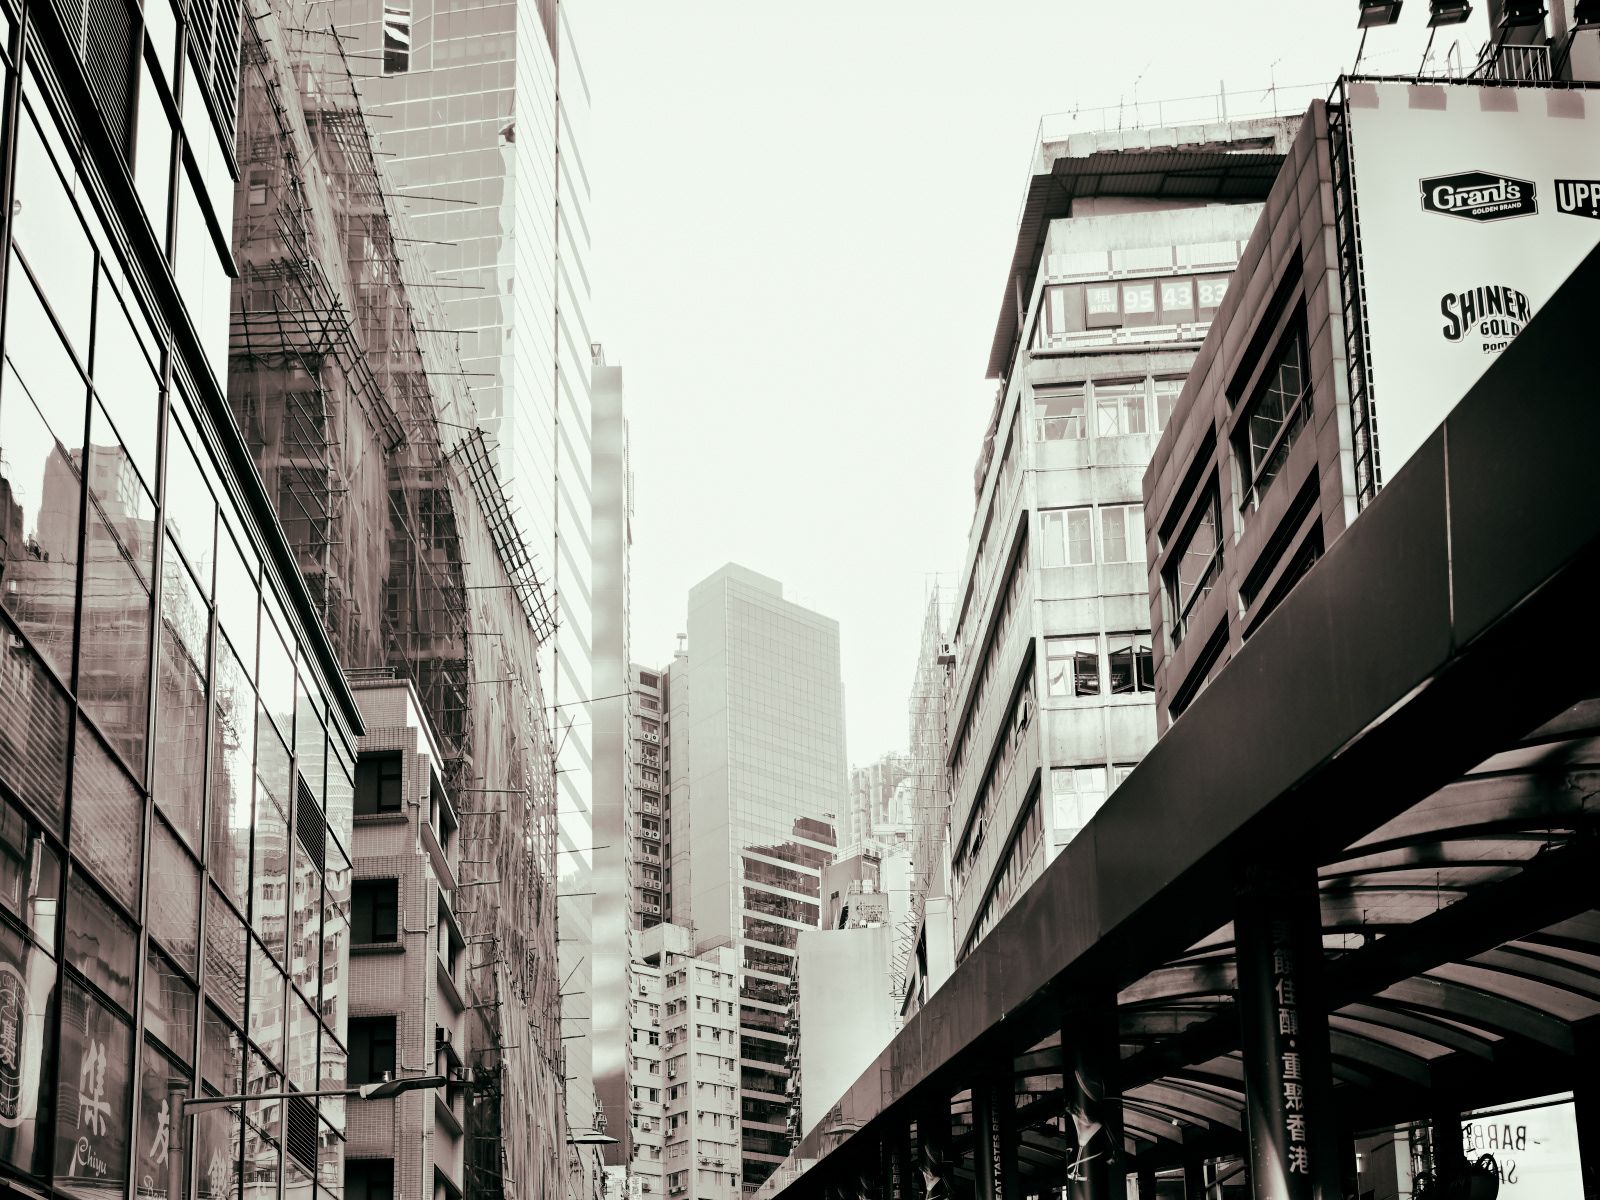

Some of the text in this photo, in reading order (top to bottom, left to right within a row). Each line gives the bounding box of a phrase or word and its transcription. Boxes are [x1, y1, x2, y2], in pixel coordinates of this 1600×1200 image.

[1432, 179, 1521, 210] Grant's
[1472, 202, 1522, 215] GOLDEN BRAND
[1440, 284, 1531, 341] SHINER
[992, 1133, 1001, 1177] TASTES
